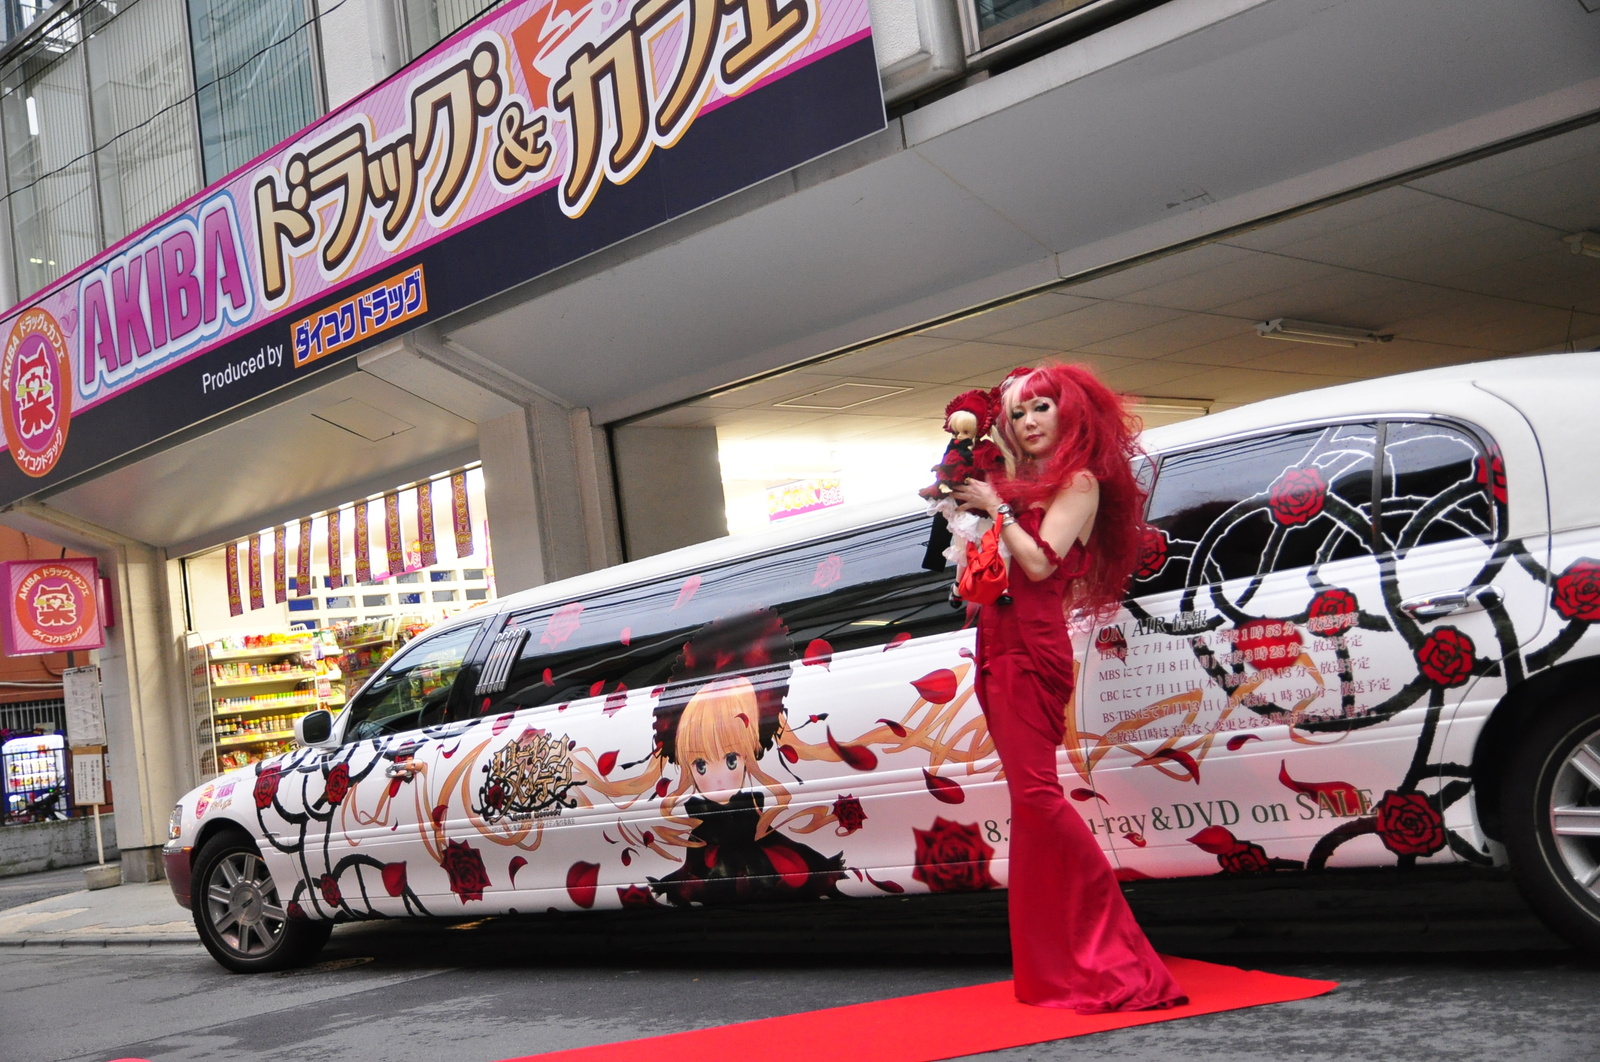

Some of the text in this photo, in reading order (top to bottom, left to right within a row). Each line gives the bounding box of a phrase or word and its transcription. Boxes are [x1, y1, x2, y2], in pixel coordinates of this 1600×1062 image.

[83, 206, 248, 386] AKIBA
[295, 268, 422, 362] ダイコクドラッグ
[2, 334, 20, 392] AKIBA
[202, 344, 283, 394] Produced by
[17, 426, 63, 472] ダイコクドラッグ
[19, 573, 41, 600] AKIBA
[32, 624, 83, 643] ダイコクドラッグ
[1098, 609, 1208, 642] ON AIR 情報
[1251, 797, 1290, 822] on
[1296, 788, 1379, 820] SALE
